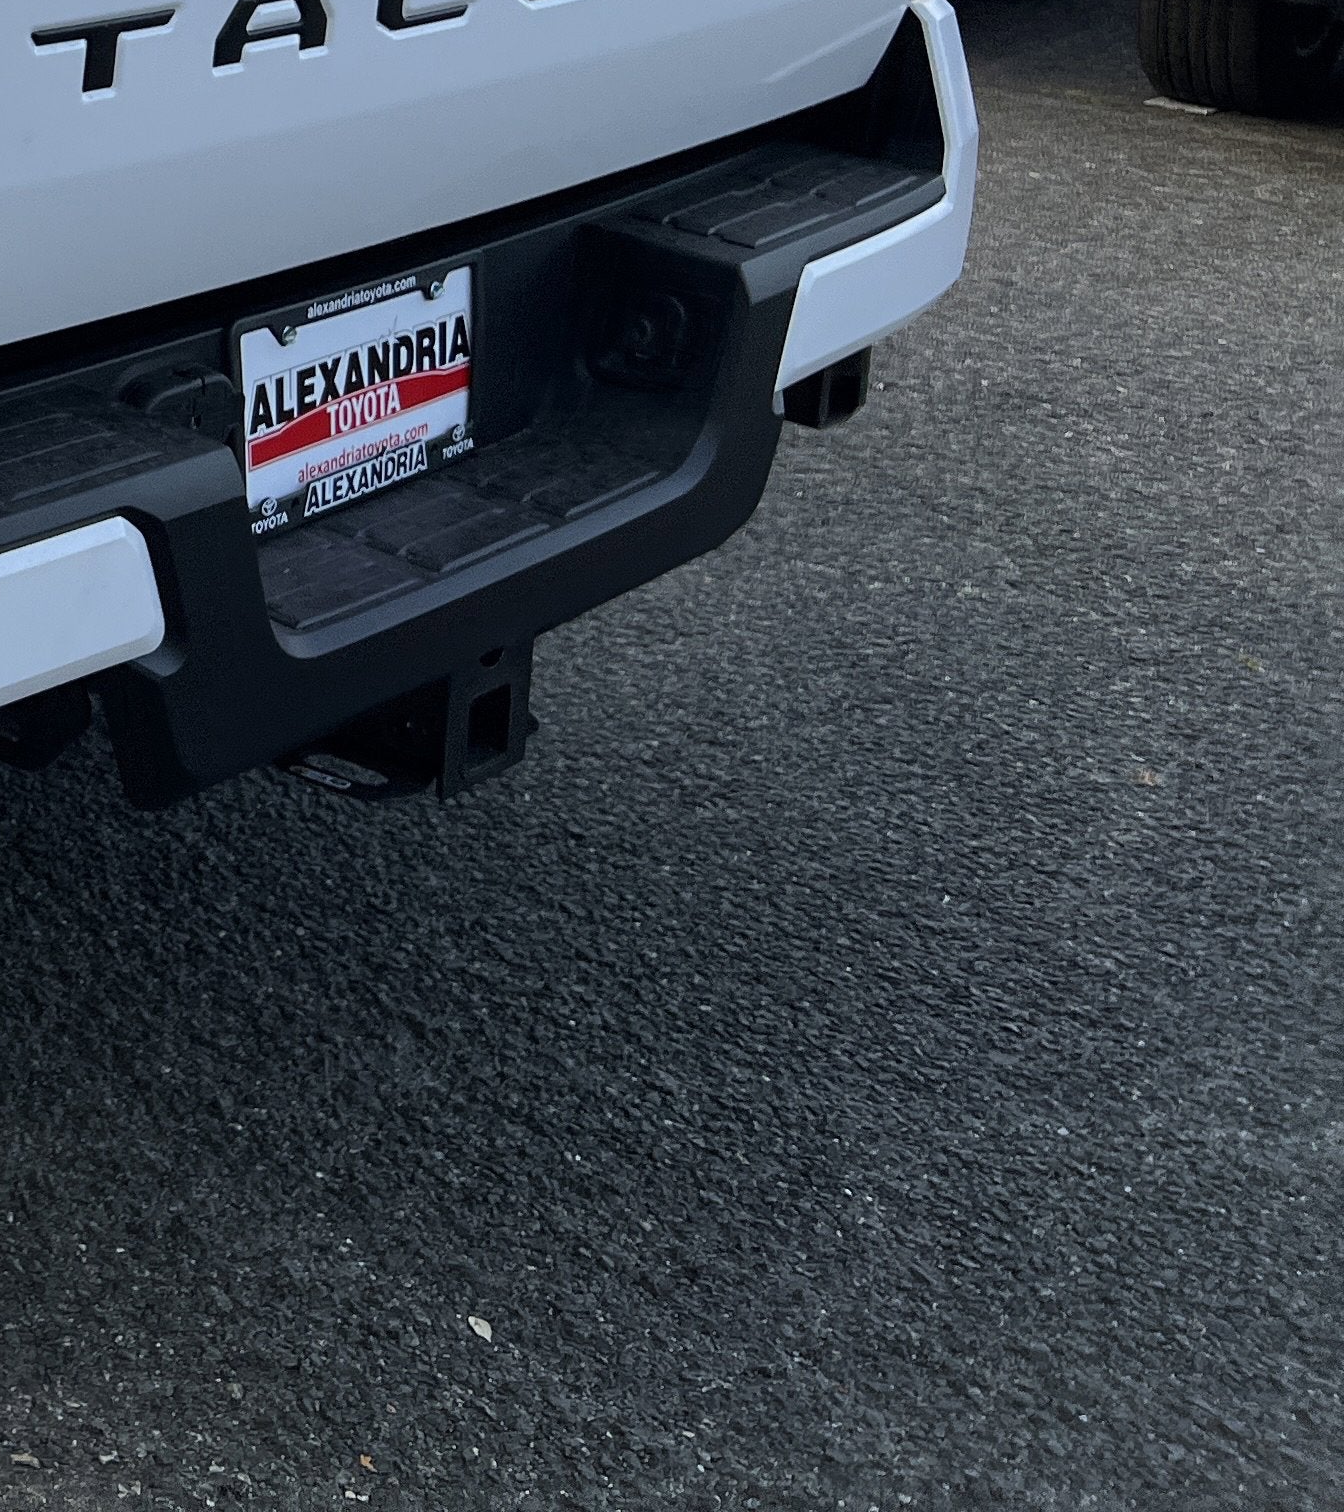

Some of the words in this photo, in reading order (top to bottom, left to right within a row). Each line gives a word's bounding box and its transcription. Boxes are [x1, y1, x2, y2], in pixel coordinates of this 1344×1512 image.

[306, 275, 417, 319] alexandriatoyota.com
[249, 311, 471, 436] ALEXANDRIA
[326, 382, 402, 437] TOYOTA
[297, 423, 429, 484] alexandriatoyota.com
[442, 438, 474, 459] TOYOTA
[304, 441, 428, 517] ALEXANDRIA
